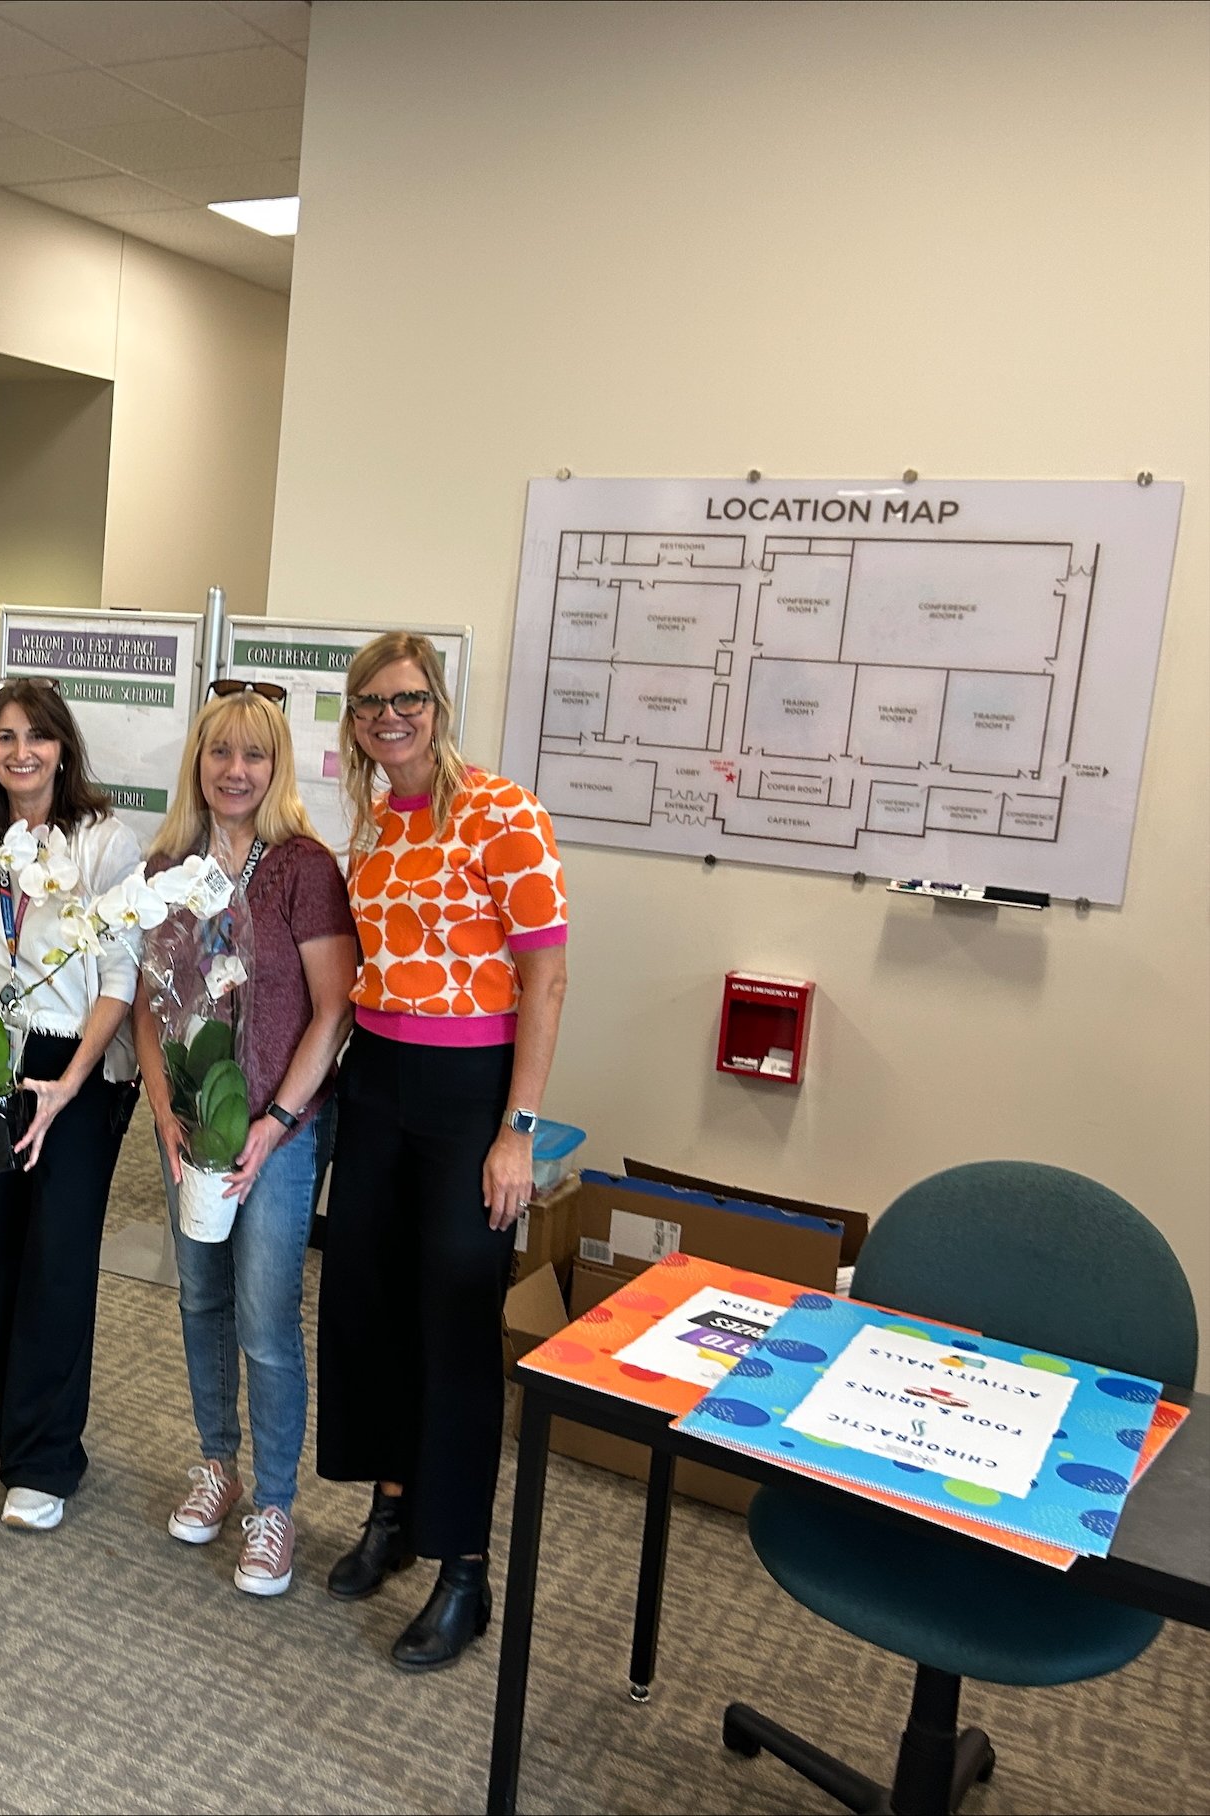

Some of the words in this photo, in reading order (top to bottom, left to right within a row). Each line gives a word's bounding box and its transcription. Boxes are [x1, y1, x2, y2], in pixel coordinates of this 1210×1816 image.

[705, 497, 871, 523] LOCATION
[882, 500, 961, 524] MAP
[660, 542, 706, 551] RESTROOMS
[776, 597, 830, 606] CONFERENCE
[787, 605, 811, 614] ROOM
[918, 602, 978, 612] CONFERENCE
[561, 611, 608, 620] CONFERENCE
[647, 614, 697, 624] CONFERENCE
[929, 611, 956, 620] ROOM
[570, 618, 592, 627] ROOM
[656, 623, 680, 632] ROOM
[21, 634, 66, 650] WELCOME
[72, 636, 84, 651] TO
[90, 638, 114, 654] EAST
[118, 639, 157, 656] BRANCH
[12, 648, 54, 665] TRAINING
[57, 652, 63, 664] /
[66, 652, 130, 670] CONFERENCE
[133, 655, 173, 673] CENTER
[247, 646, 321, 667] CONFERENCE
[74, 682, 116, 700] MEETING
[120, 686, 168, 704] SCHEDULE
[552, 688, 600, 698] CONFERENCE
[562, 696, 584, 706] ROOM
[638, 695, 688, 705] CONFERENCE
[782, 698, 820, 709] TRAINING
[648, 703, 670, 712] ROOM
[784, 706, 810, 716] ROOM
[878, 705, 918, 716] TRAINING
[880, 714, 906, 724] ROOM
[973, 712, 1015, 723] TRAINING
[975, 720, 1002, 730] ROOM
[675, 768, 700, 777] LOBBY
[569, 781, 614, 792] RESTROOMS
[766, 783, 796, 794] COPIER
[797, 785, 822, 796] ROOM
[664, 802, 705, 812] ENTRANCE
[876, 799, 920, 809] CONFERENCE
[942, 804, 988, 815] CONFERENCE
[767, 816, 811, 828] CAFETERIA
[719, 1299, 783, 1320] ATION
[698, 1334, 736, 1350] TO
[869, 1347, 935, 1372] WALLS
[945, 1369, 1042, 1399] ACTIVITY
[844, 1380, 927, 1409] DRINKS
[938, 1406, 952, 1416] &
[962, 1414, 1023, 1437] FOOD
[826, 1412, 998, 1469] CHIROPRACTIC
